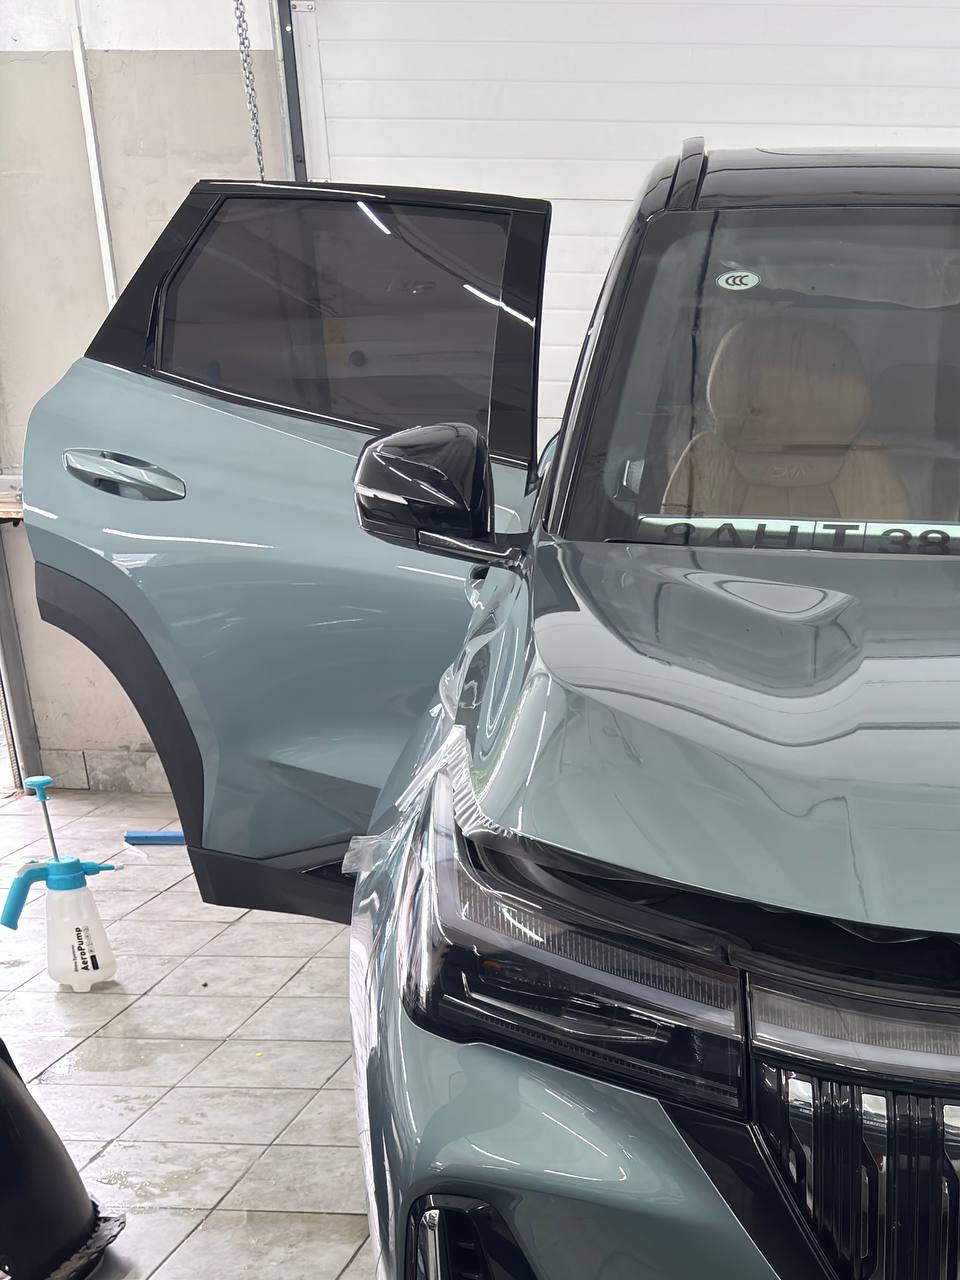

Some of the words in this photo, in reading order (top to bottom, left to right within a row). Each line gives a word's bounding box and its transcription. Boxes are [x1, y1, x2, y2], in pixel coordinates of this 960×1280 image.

[725, 274, 749, 287] CCC
[822, 523, 860, 552] T
[75, 927, 90, 971] AeroPump
